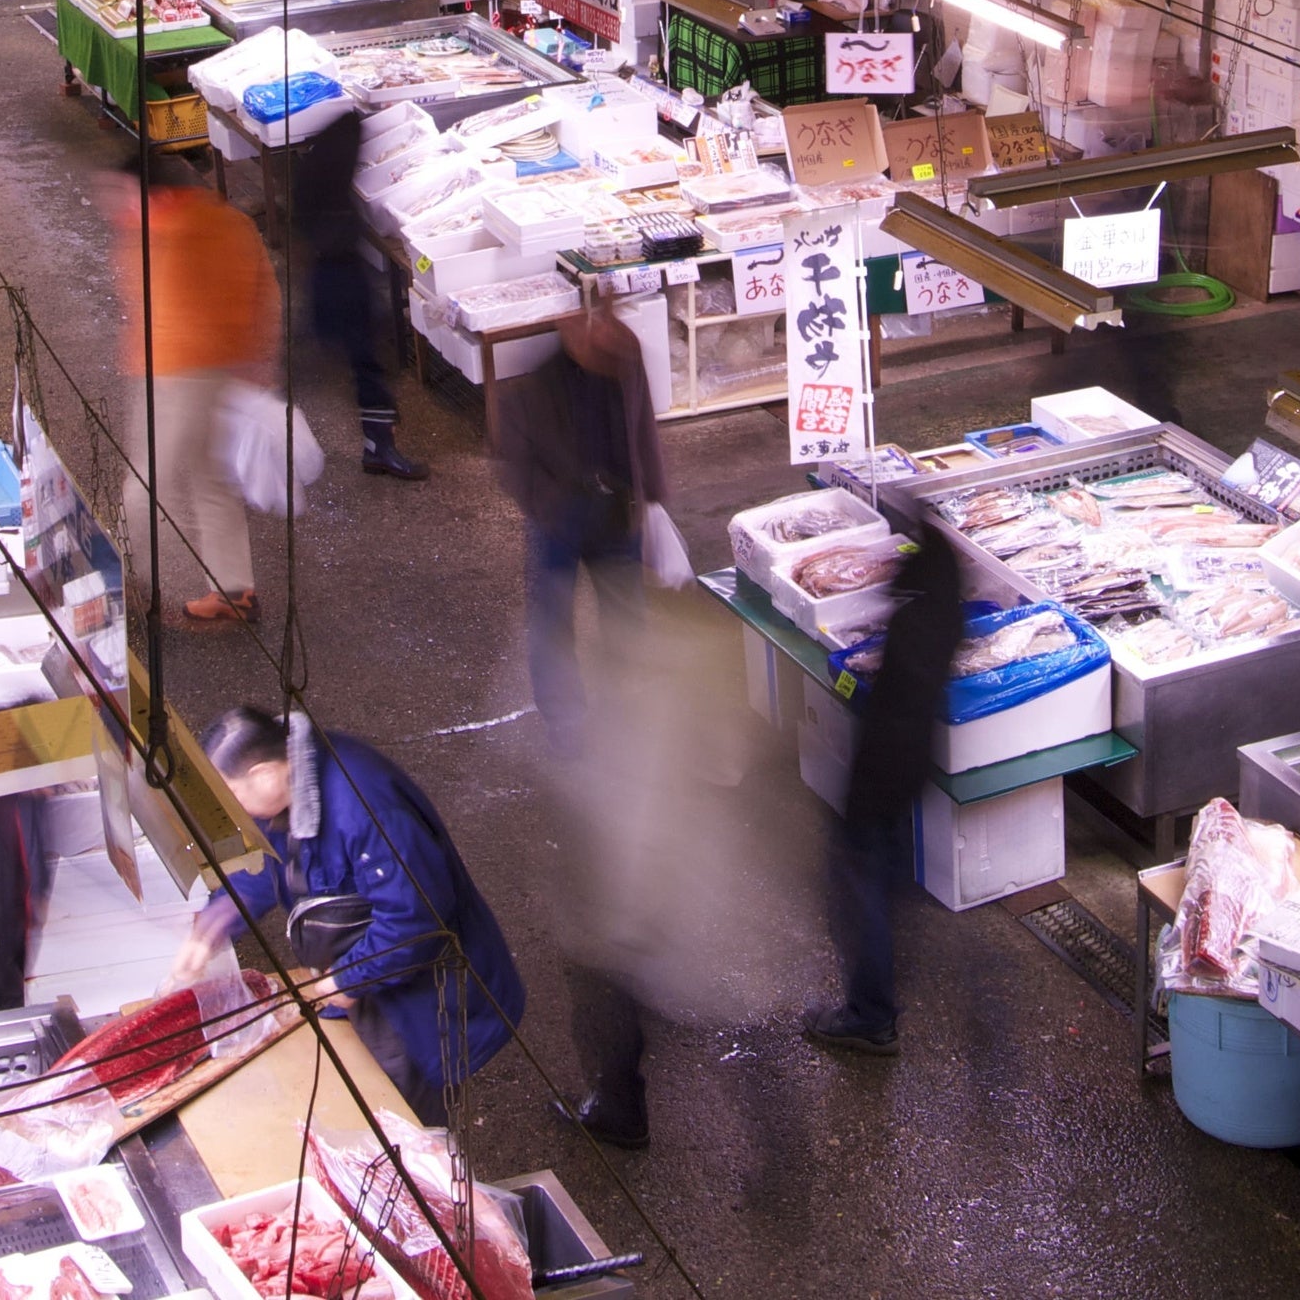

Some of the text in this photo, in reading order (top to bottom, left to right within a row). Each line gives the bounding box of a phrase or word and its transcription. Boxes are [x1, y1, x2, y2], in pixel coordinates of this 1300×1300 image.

[835, 55, 903, 85] うなぎ
[797, 116, 856, 150] うなぎ
[906, 129, 956, 161] うなぎ
[1000, 137, 1035, 156] うなぎ
